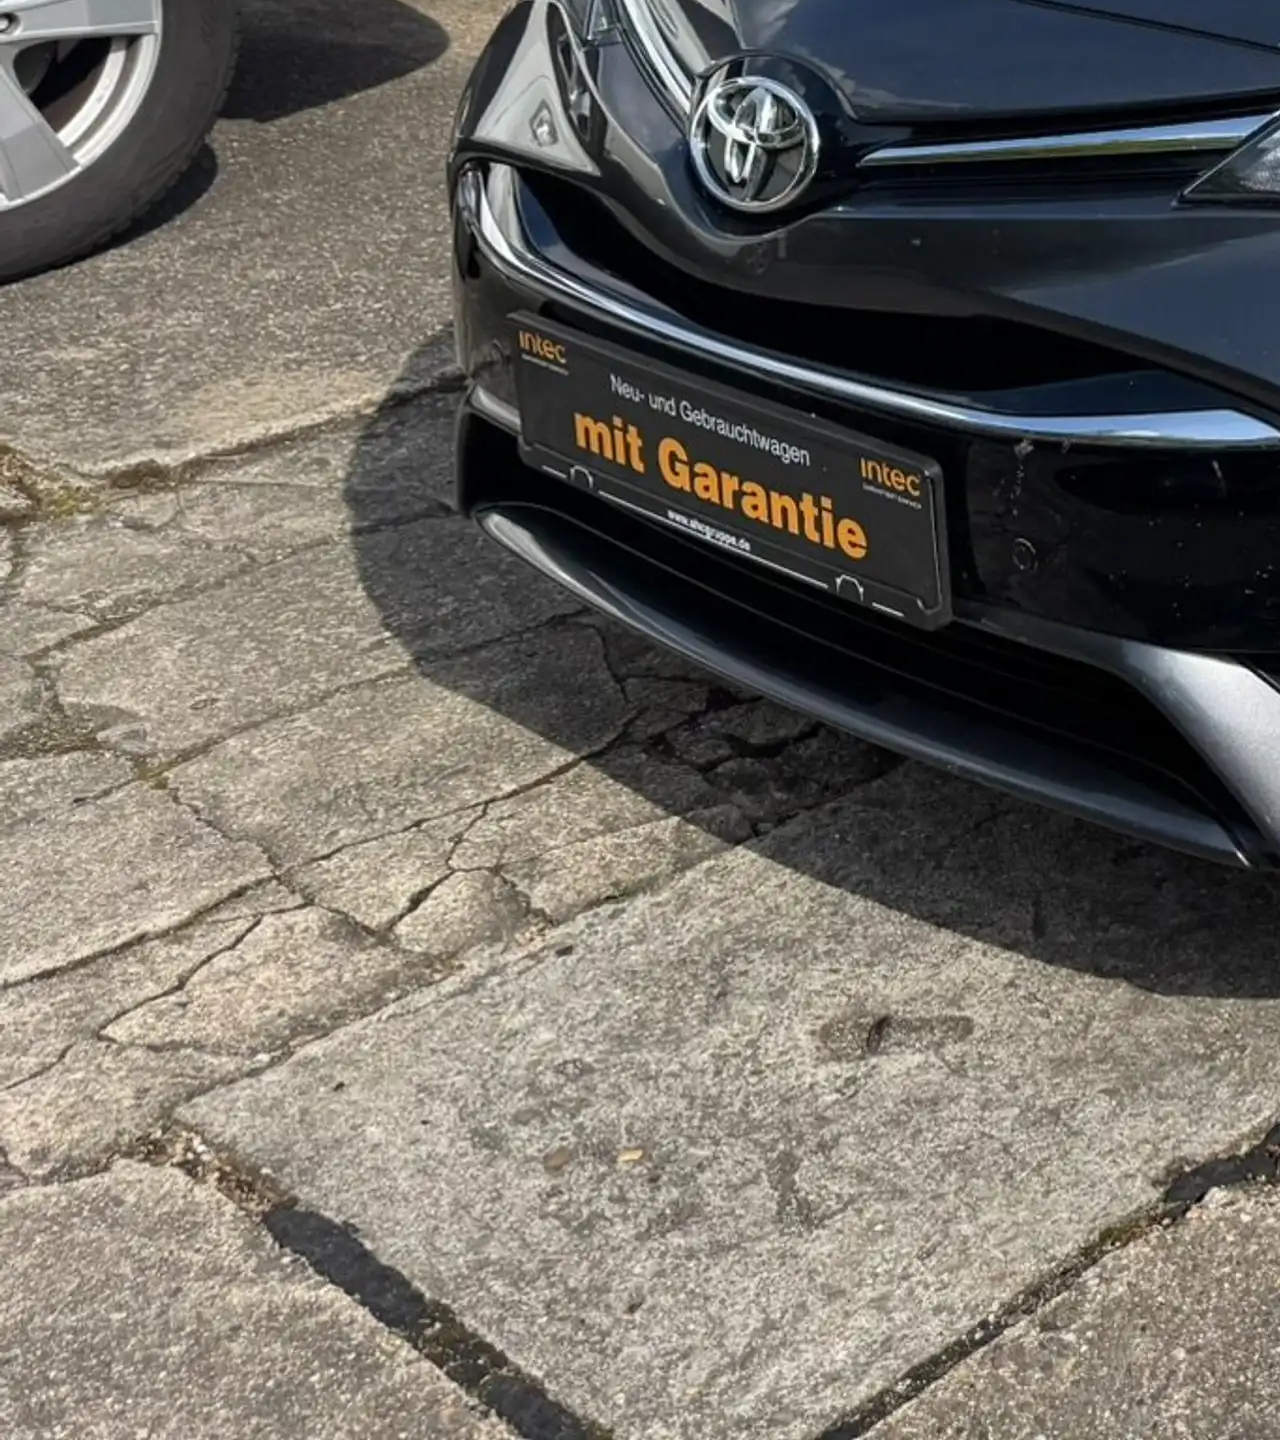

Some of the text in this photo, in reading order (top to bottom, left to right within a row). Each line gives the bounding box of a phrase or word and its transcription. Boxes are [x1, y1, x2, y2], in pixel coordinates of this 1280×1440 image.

[609, 373, 811, 467] Neu- und Gebrauchtwagen
[573, 411, 869, 560] mit Garantie
[860, 456, 921, 497] intec
